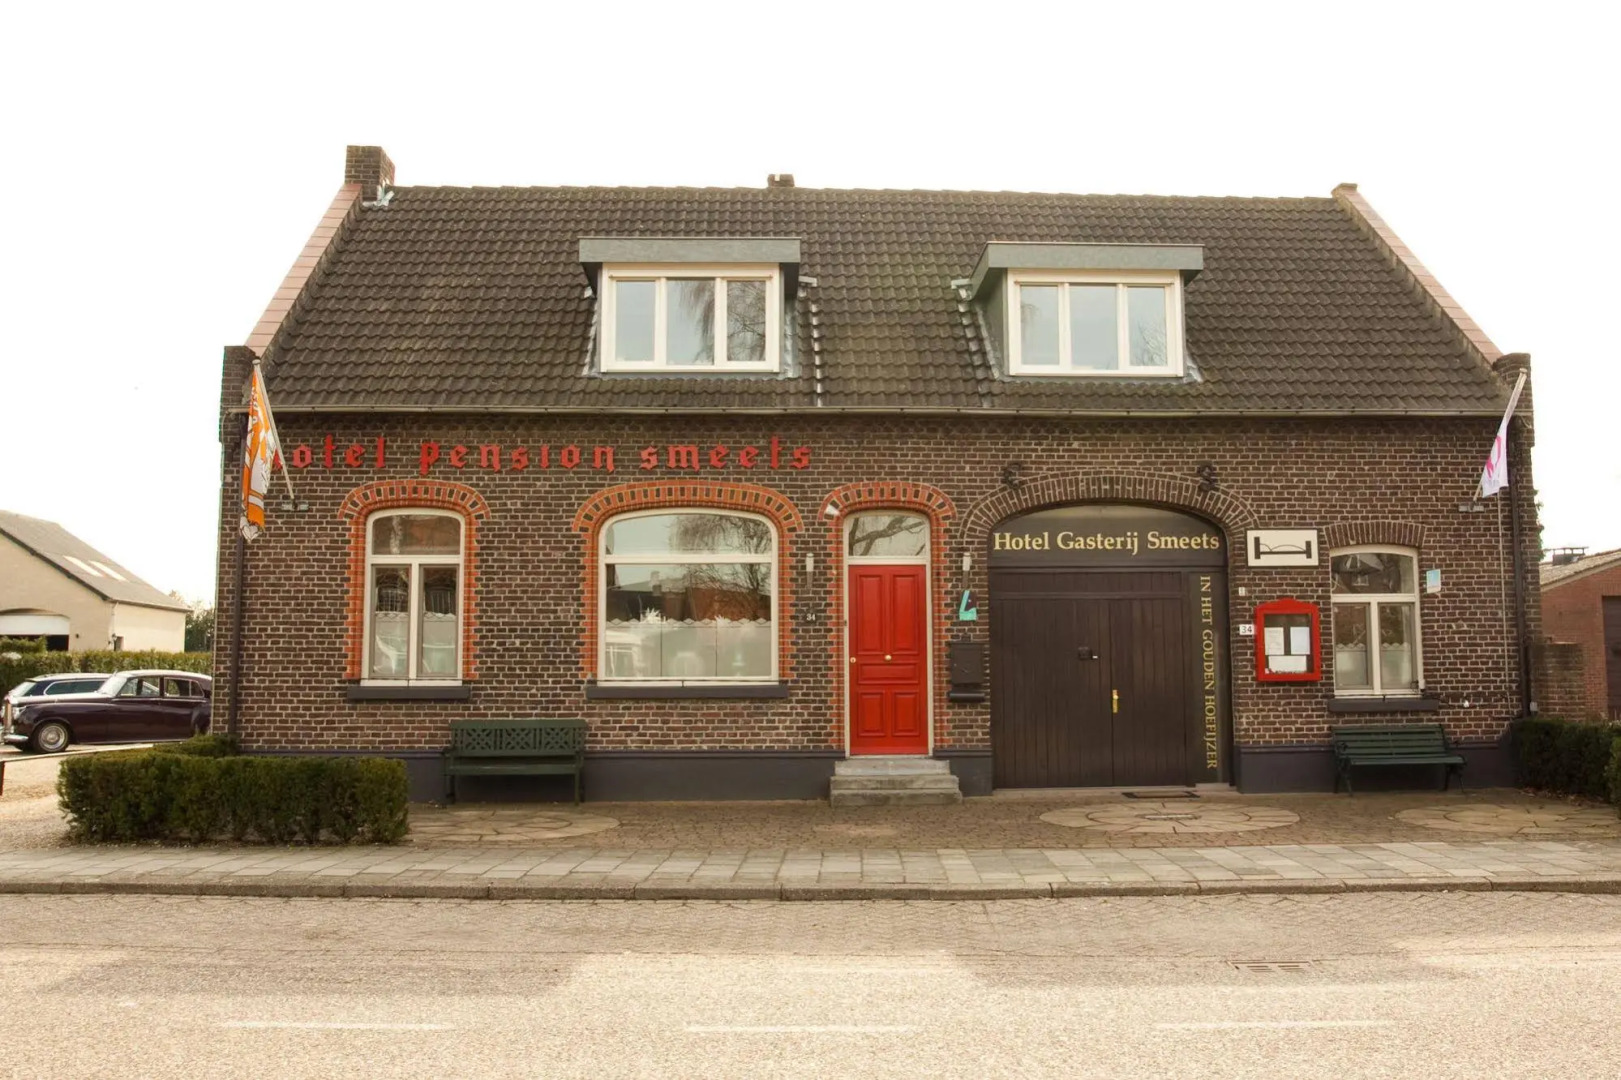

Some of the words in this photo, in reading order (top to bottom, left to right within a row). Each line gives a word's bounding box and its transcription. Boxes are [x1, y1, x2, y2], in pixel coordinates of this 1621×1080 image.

[419, 441, 614, 476] pension
[639, 434, 812, 473] smeets
[993, 531, 1050, 550] Hotel
[1056, 531, 1139, 556] Gasterij
[1147, 531, 1220, 550] Smeets
[1200, 575, 1211, 592] IN
[1201, 597, 1213, 626] HET
[1241, 625, 1253, 634] 34
[1202, 629, 1215, 690] GOUDEN
[1203, 695, 1218, 769] HOEFIJZER
